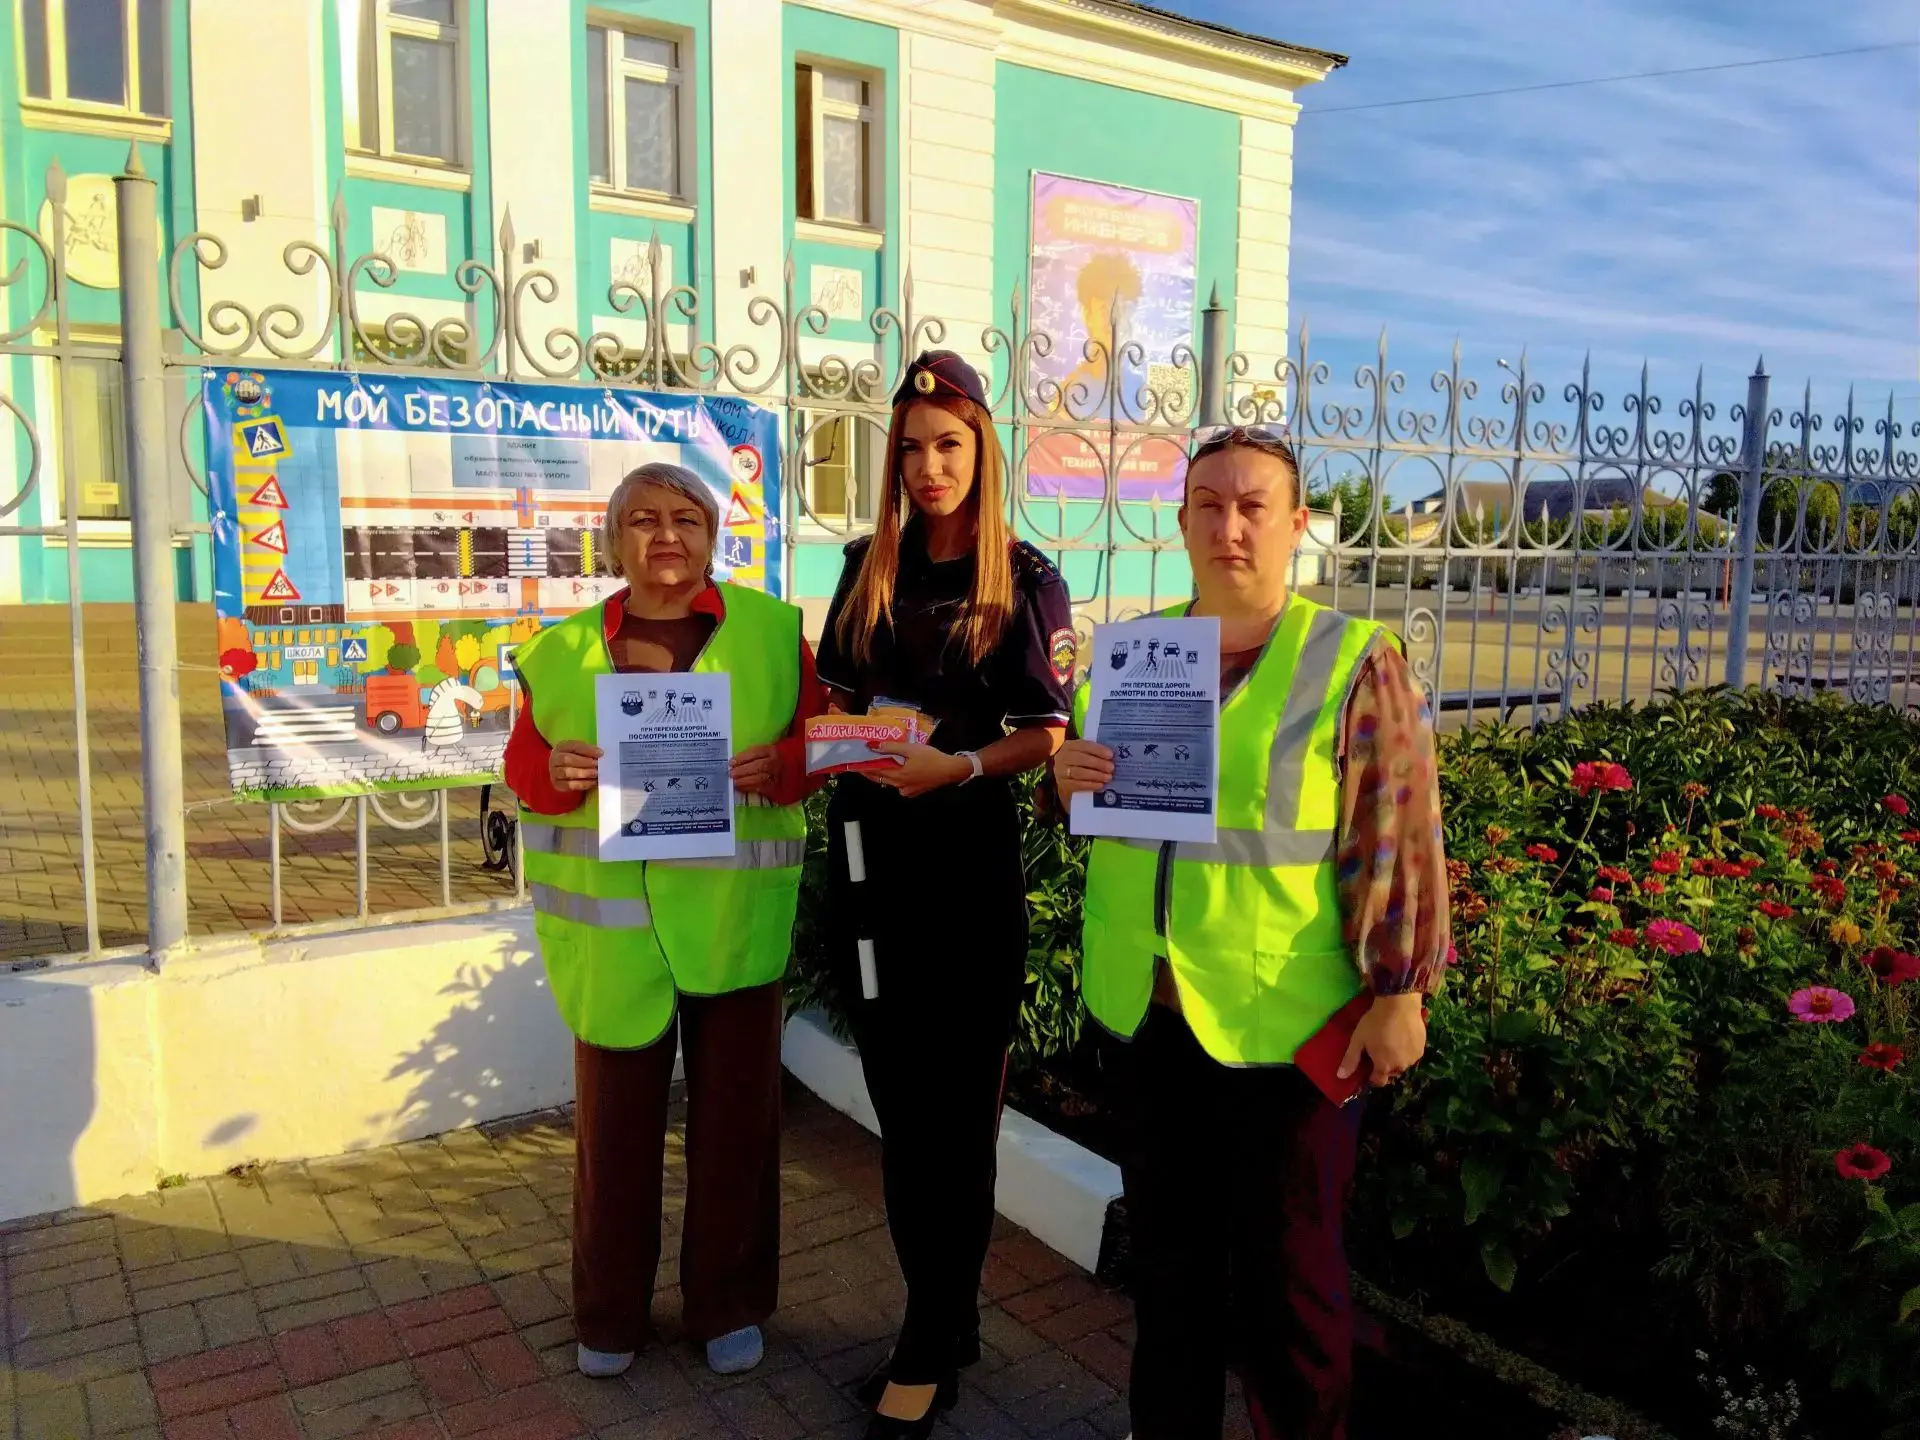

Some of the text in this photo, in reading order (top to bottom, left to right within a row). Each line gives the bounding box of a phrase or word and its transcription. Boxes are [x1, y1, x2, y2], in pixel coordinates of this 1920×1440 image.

[317, 384, 701, 438] МОЙ БЕЗОПАСНЫЙ ПУТЬ
[710, 396, 742, 418] ДОМ
[287, 648, 322, 658] ШКОЛА
[1160, 690, 1206, 698] СТОРОНАМ!
[680, 731, 721, 739] СТОРОНАМ!
[857, 724, 889, 740] ЯРКО
